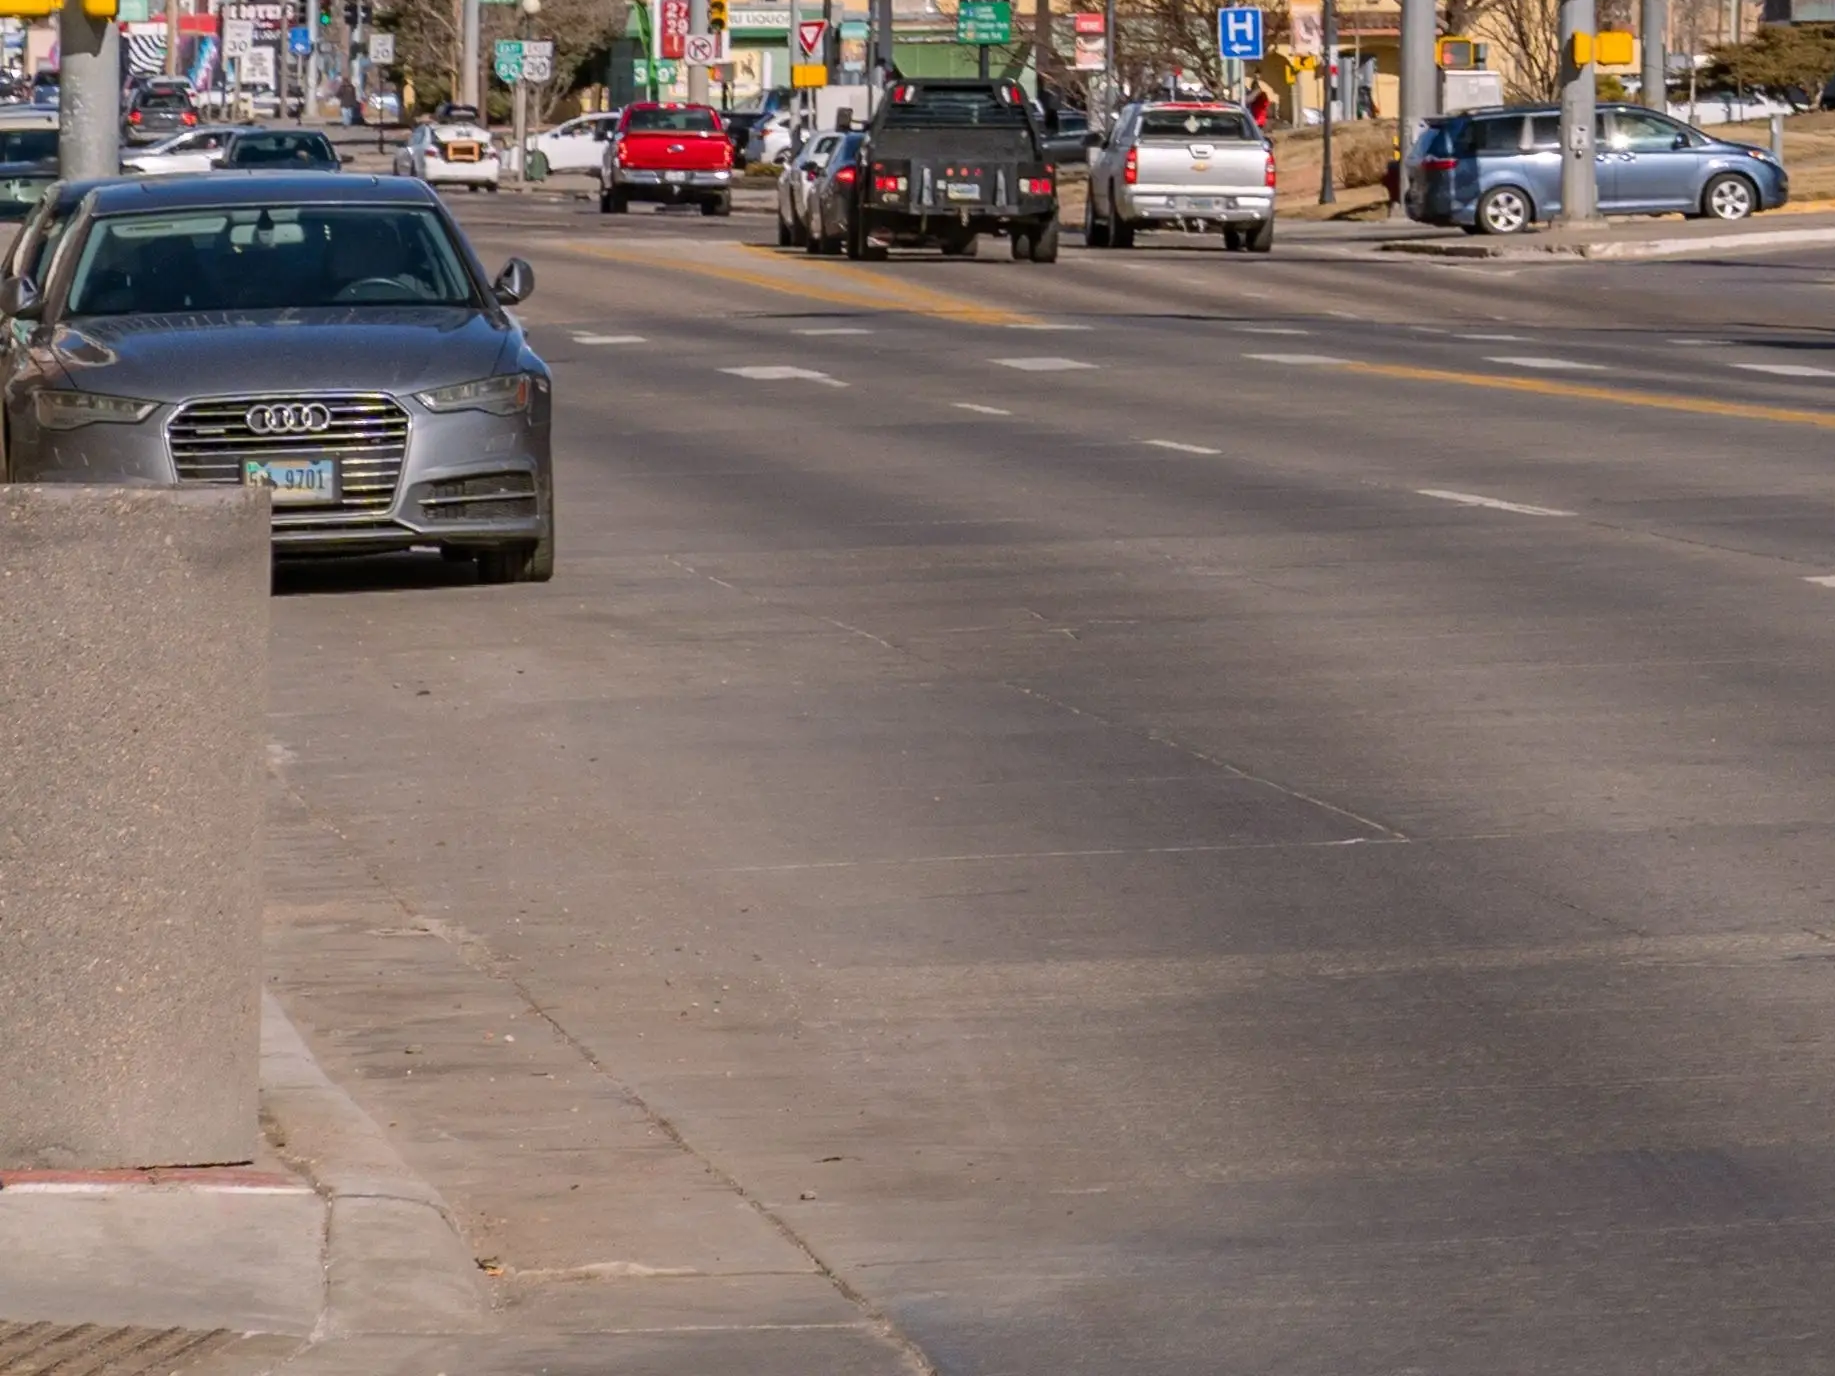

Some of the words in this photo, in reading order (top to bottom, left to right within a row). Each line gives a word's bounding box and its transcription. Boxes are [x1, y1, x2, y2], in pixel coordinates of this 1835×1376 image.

[746, 13, 790, 25] LIQUO
[1228, 12, 1254, 42] H
[285, 469, 325, 490] 9701
